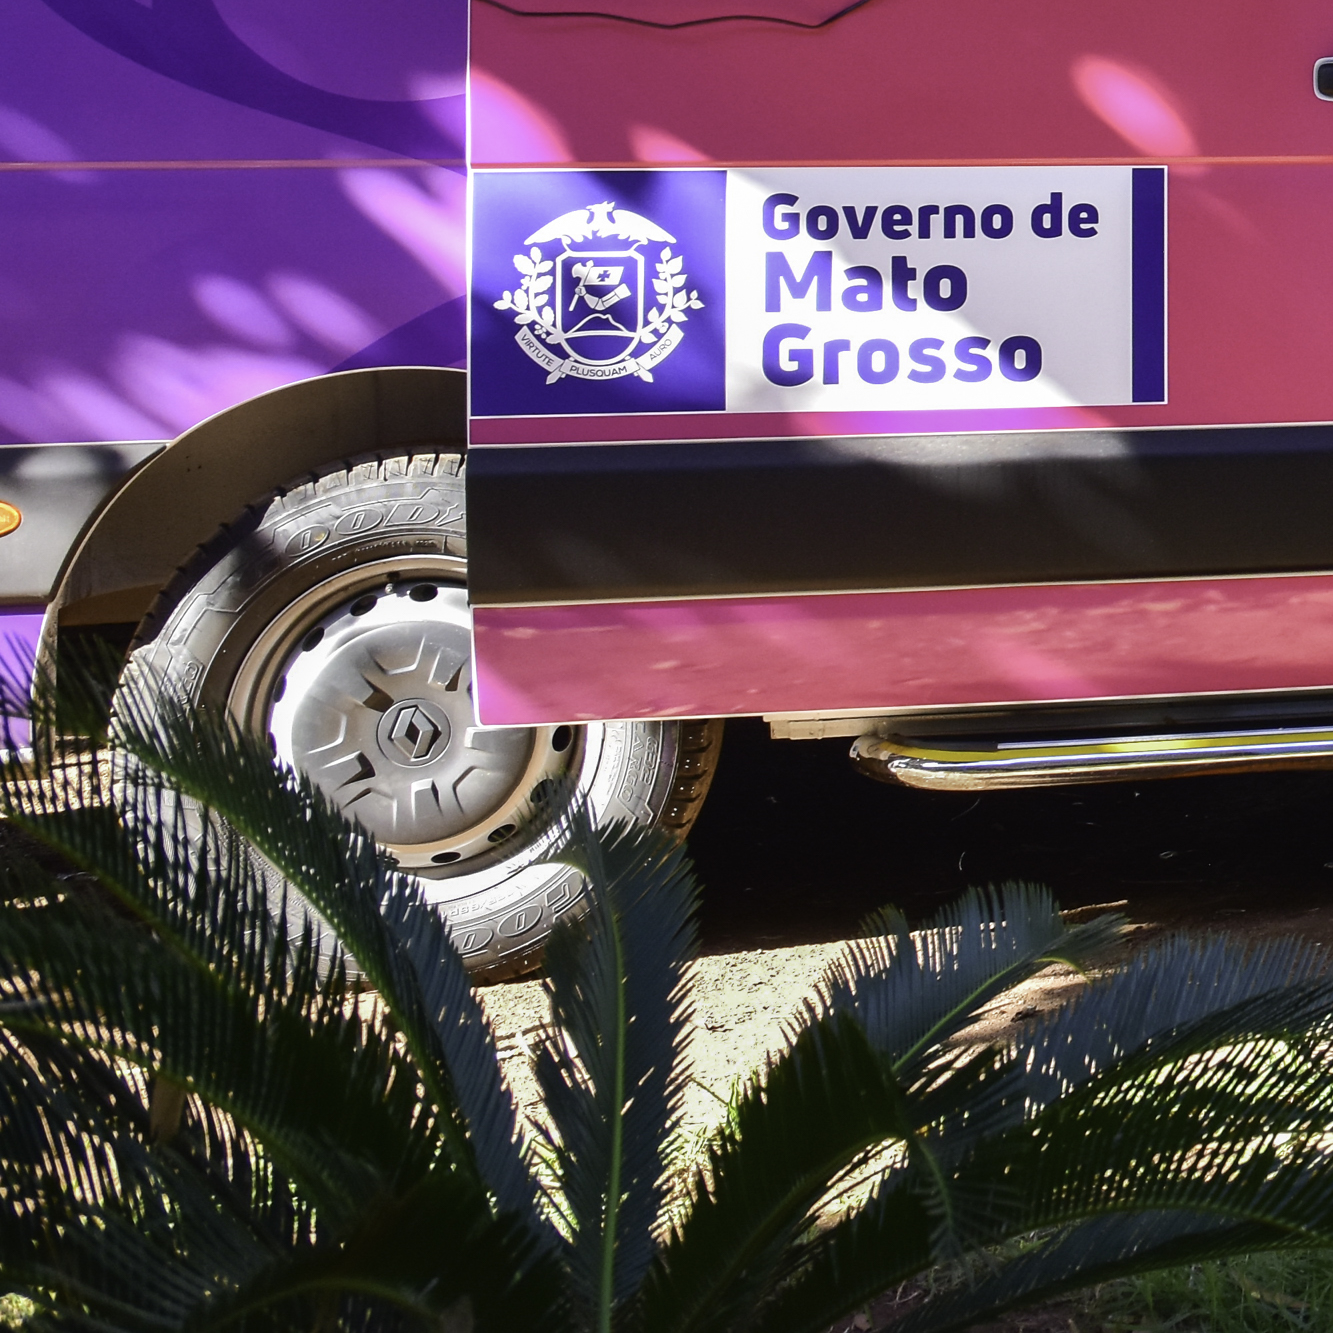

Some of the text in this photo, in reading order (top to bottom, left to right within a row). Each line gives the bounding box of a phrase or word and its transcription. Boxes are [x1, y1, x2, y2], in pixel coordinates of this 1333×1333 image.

[763, 191, 1100, 241] Governo de
[764, 249, 969, 313] Mato
[520, 333, 673, 378] VIRTUTE PLUSQUAM AURO
[761, 322, 1043, 388] Grosso
